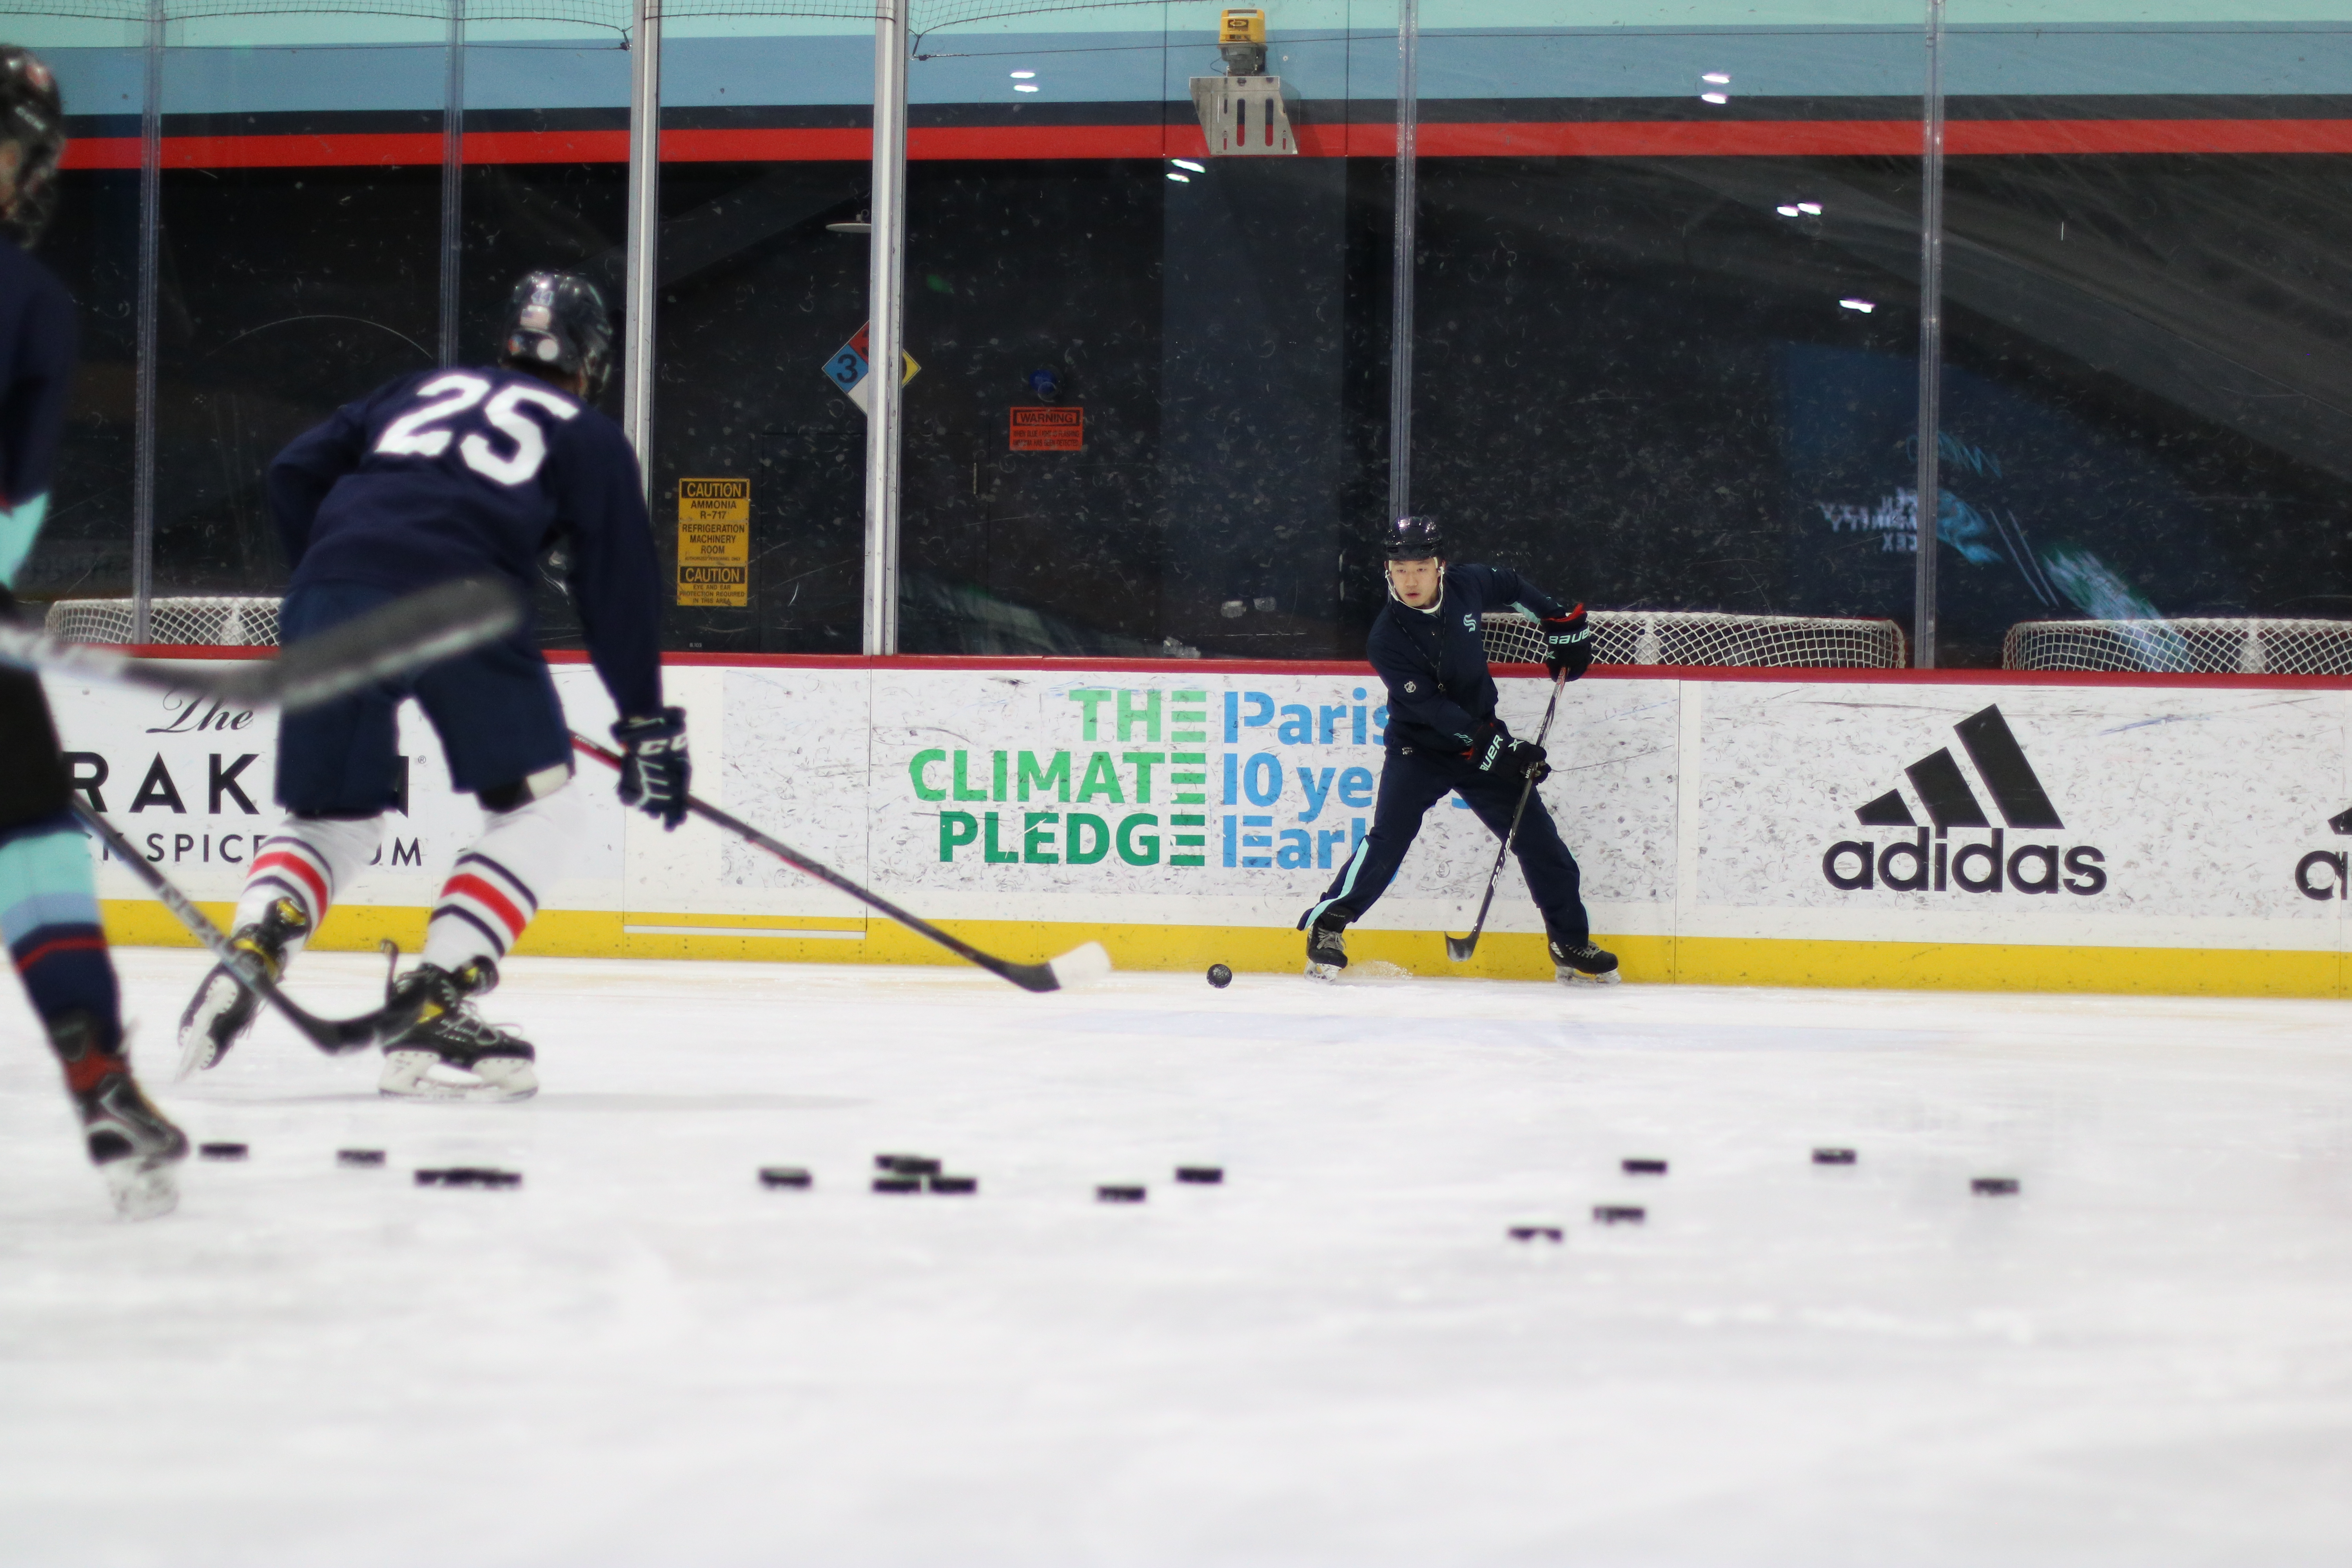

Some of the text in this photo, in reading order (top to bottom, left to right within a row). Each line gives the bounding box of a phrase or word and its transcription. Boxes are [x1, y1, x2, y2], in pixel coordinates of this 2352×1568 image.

[837, 354, 858, 383] 3
[375, 374, 579, 486] 25
[1020, 413, 1073, 423] WARNING
[687, 482, 741, 497] CAUTION
[690, 500, 737, 509] AMMONIA
[700, 510, 727, 519] R-717
[682, 524, 745, 533] REFRIGERATION
[690, 534, 736, 543] MACHINERY
[701, 545, 725, 554] ROOM
[685, 568, 740, 583] CAUTION
[1548, 625, 1590, 644] BAUE
[145, 690, 254, 734] The
[1069, 690, 1207, 743] THE
[908, 748, 1206, 805] CLIMATE
[1223, 752, 1283, 808] 10
[939, 811, 1205, 867] PLEDGE
[1222, 815, 1366, 869] Earl
[1822, 826, 2107, 895] adidas
